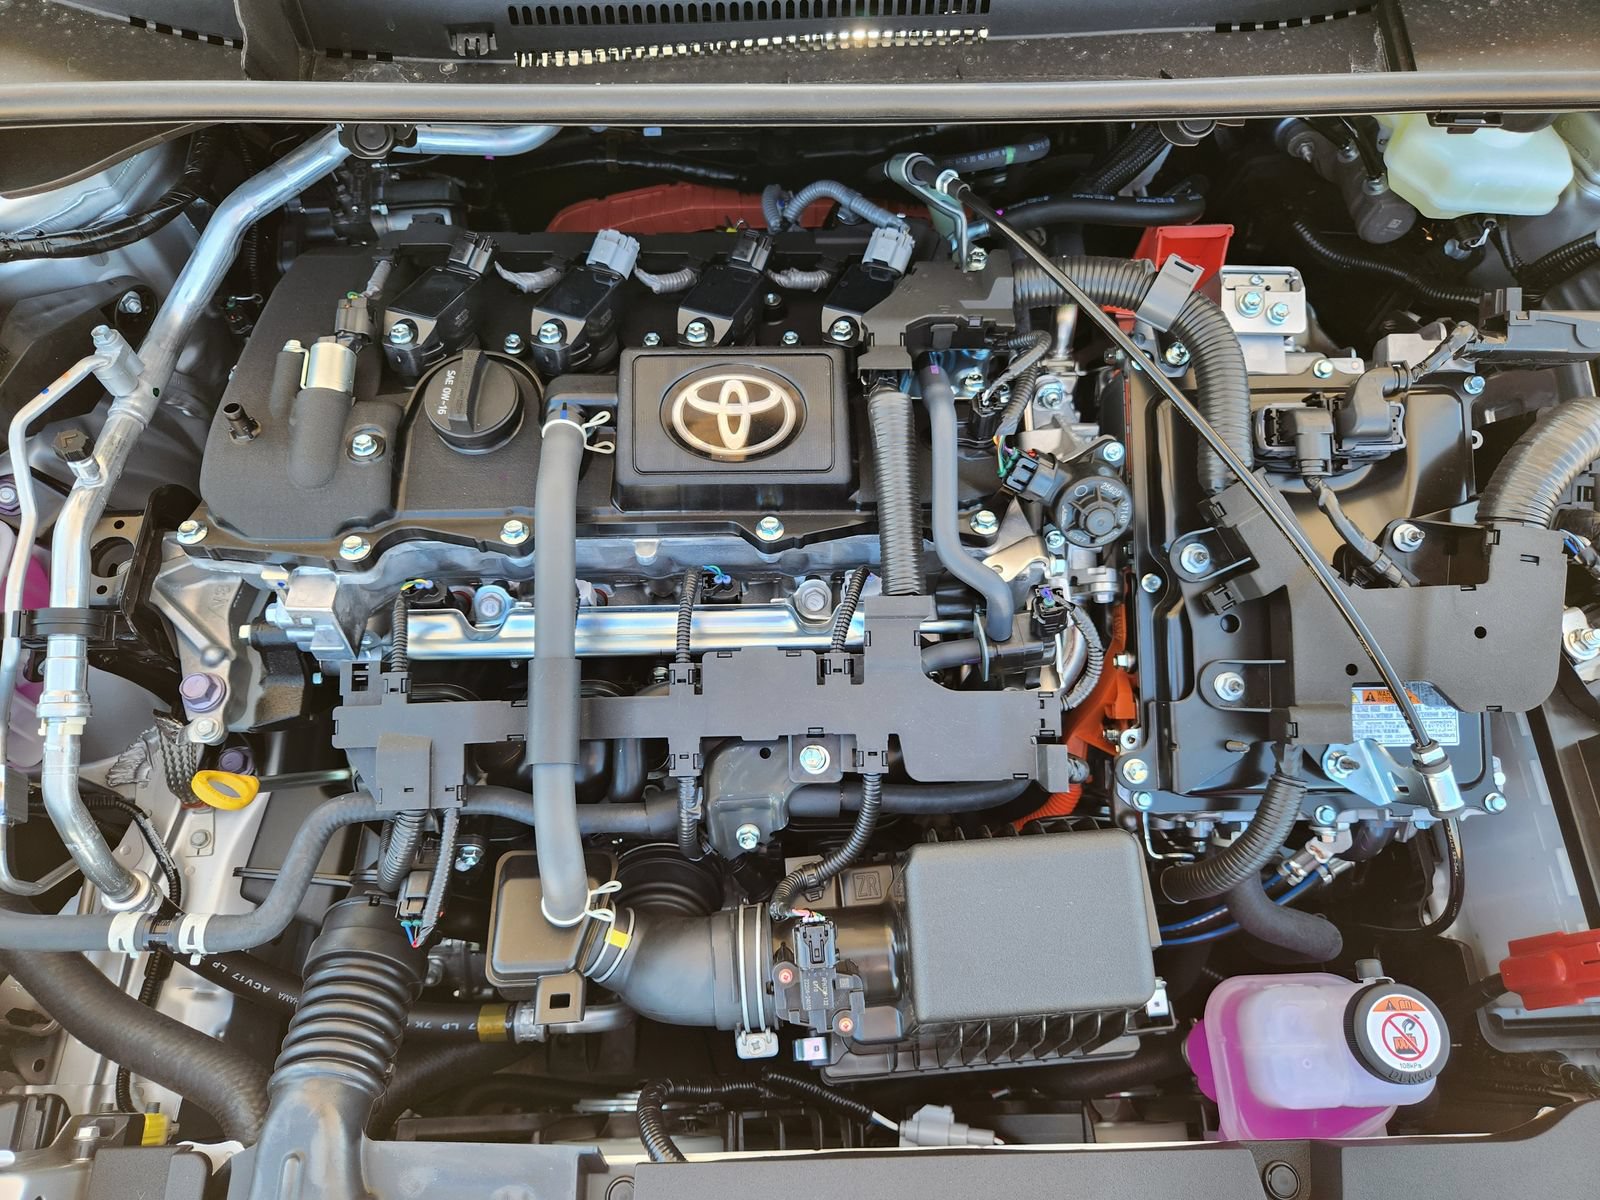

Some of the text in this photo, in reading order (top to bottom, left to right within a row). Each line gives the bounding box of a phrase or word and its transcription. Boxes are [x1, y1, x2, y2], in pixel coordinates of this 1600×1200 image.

[437, 370, 457, 415] SAE 0W-16
[1100, 481, 1122, 497] 25620
[856, 874, 879, 897] ZR
[211, 960, 228, 973] LP
[231, 972, 271, 993] ACV17
[441, 1022, 460, 1031] LP
[1399, 1062, 1423, 1070] 108kPa
[1388, 1069, 1432, 1084] DENSO
